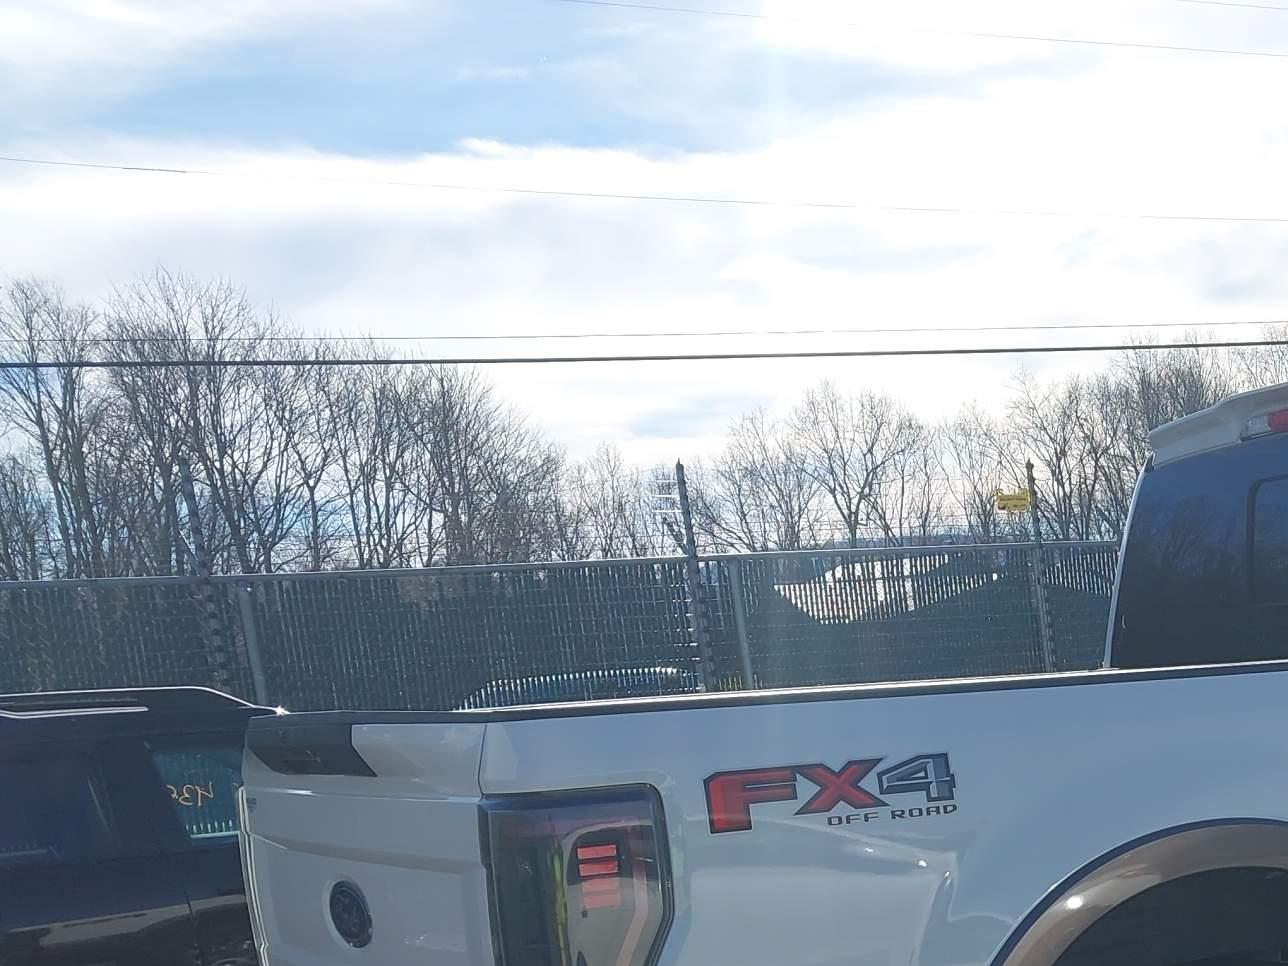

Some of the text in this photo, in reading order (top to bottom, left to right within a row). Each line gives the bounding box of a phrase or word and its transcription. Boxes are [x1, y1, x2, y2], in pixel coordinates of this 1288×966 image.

[703, 752, 955, 834] FX4
[827, 803, 958, 826] OFF ROAD
